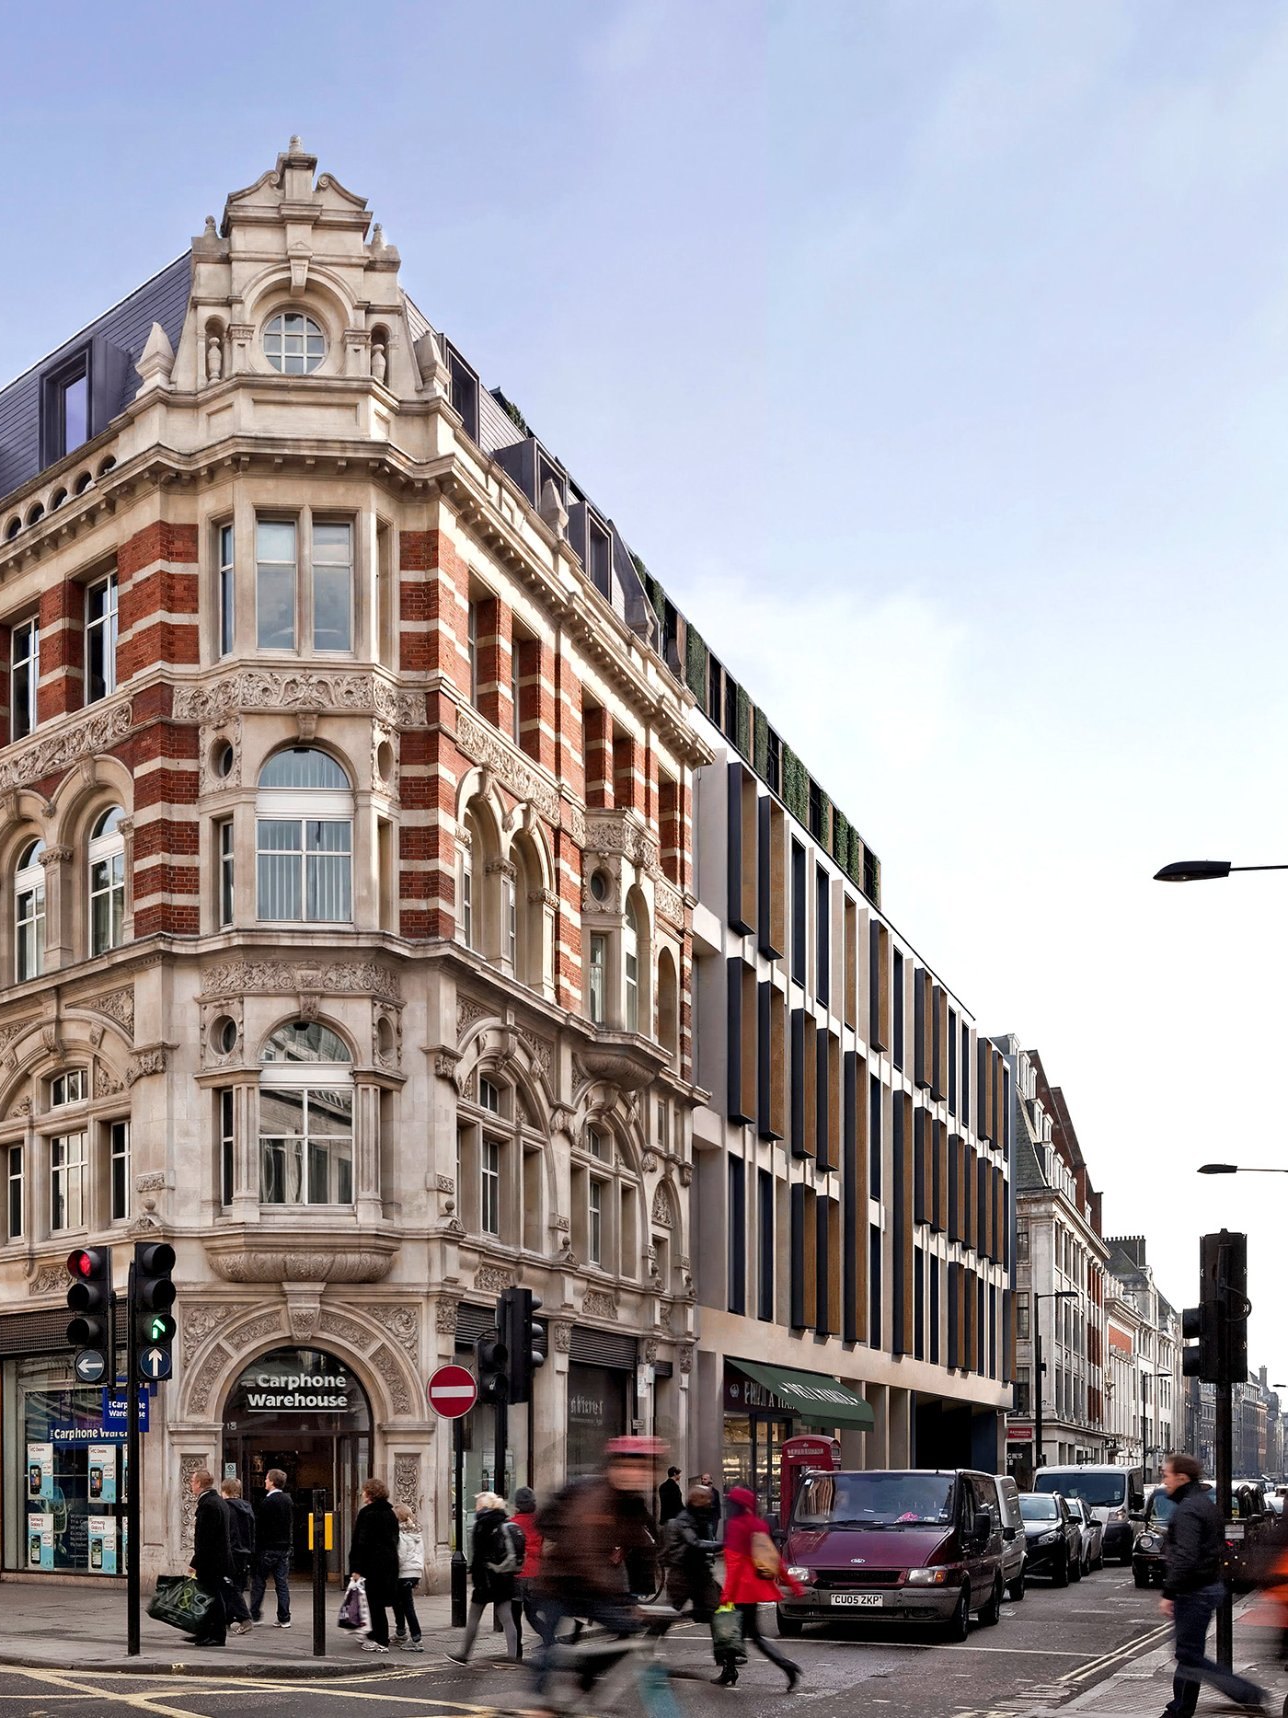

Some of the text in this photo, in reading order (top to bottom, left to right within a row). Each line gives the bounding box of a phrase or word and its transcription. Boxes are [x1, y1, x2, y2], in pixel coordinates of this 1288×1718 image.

[256, 1373, 346, 1390] Carphone
[248, 1393, 348, 1406] Warehouse
[54, 1428, 98, 1440] Carphone
[834, 1596, 879, 1604] CU05 ZKP
